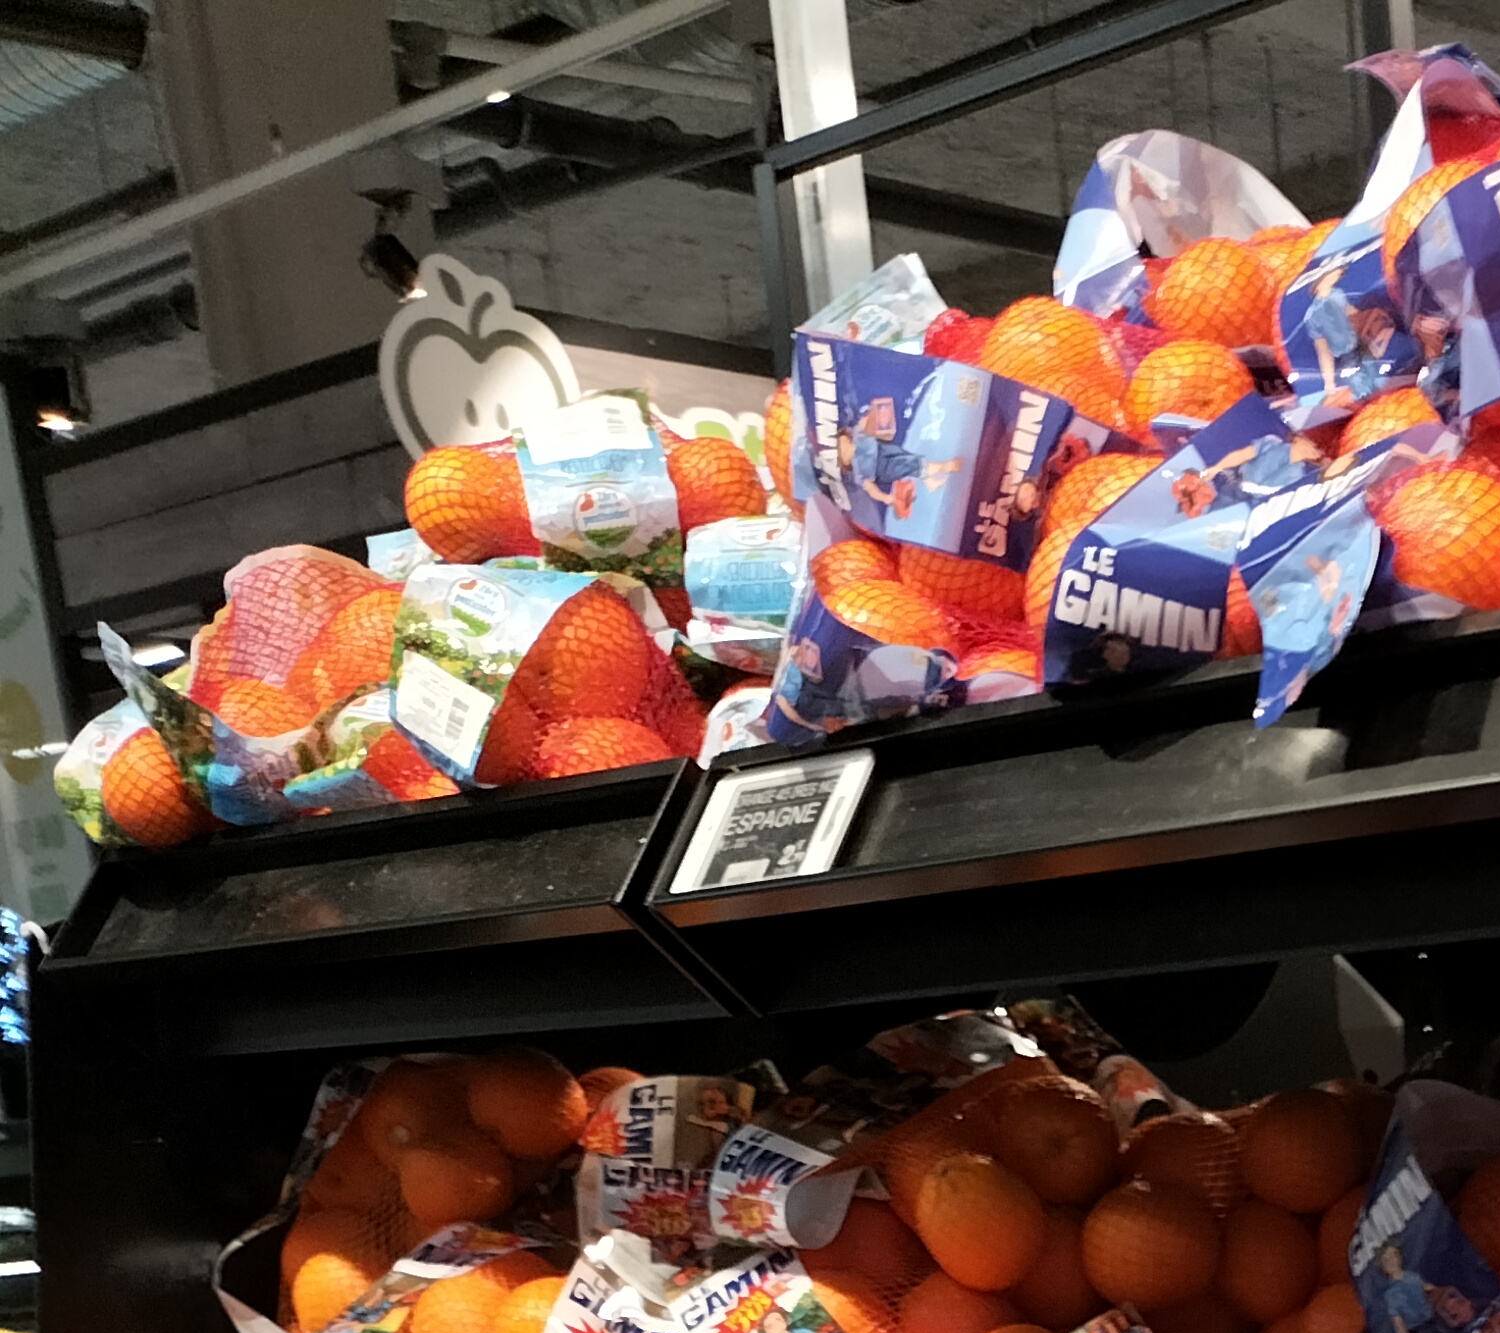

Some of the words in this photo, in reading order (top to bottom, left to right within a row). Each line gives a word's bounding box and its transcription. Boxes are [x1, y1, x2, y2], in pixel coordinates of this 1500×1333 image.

[976, 390, 1050, 558] GAMIN
[1083, 545, 1118, 576] LE
[1054, 568, 1221, 653] GAMIN
[722, 801, 822, 837] ESPAGNE
[656, 1095, 674, 1117] LE
[719, 1139, 807, 1187] GAMIN
[681, 1249, 794, 1331] GAMIN
